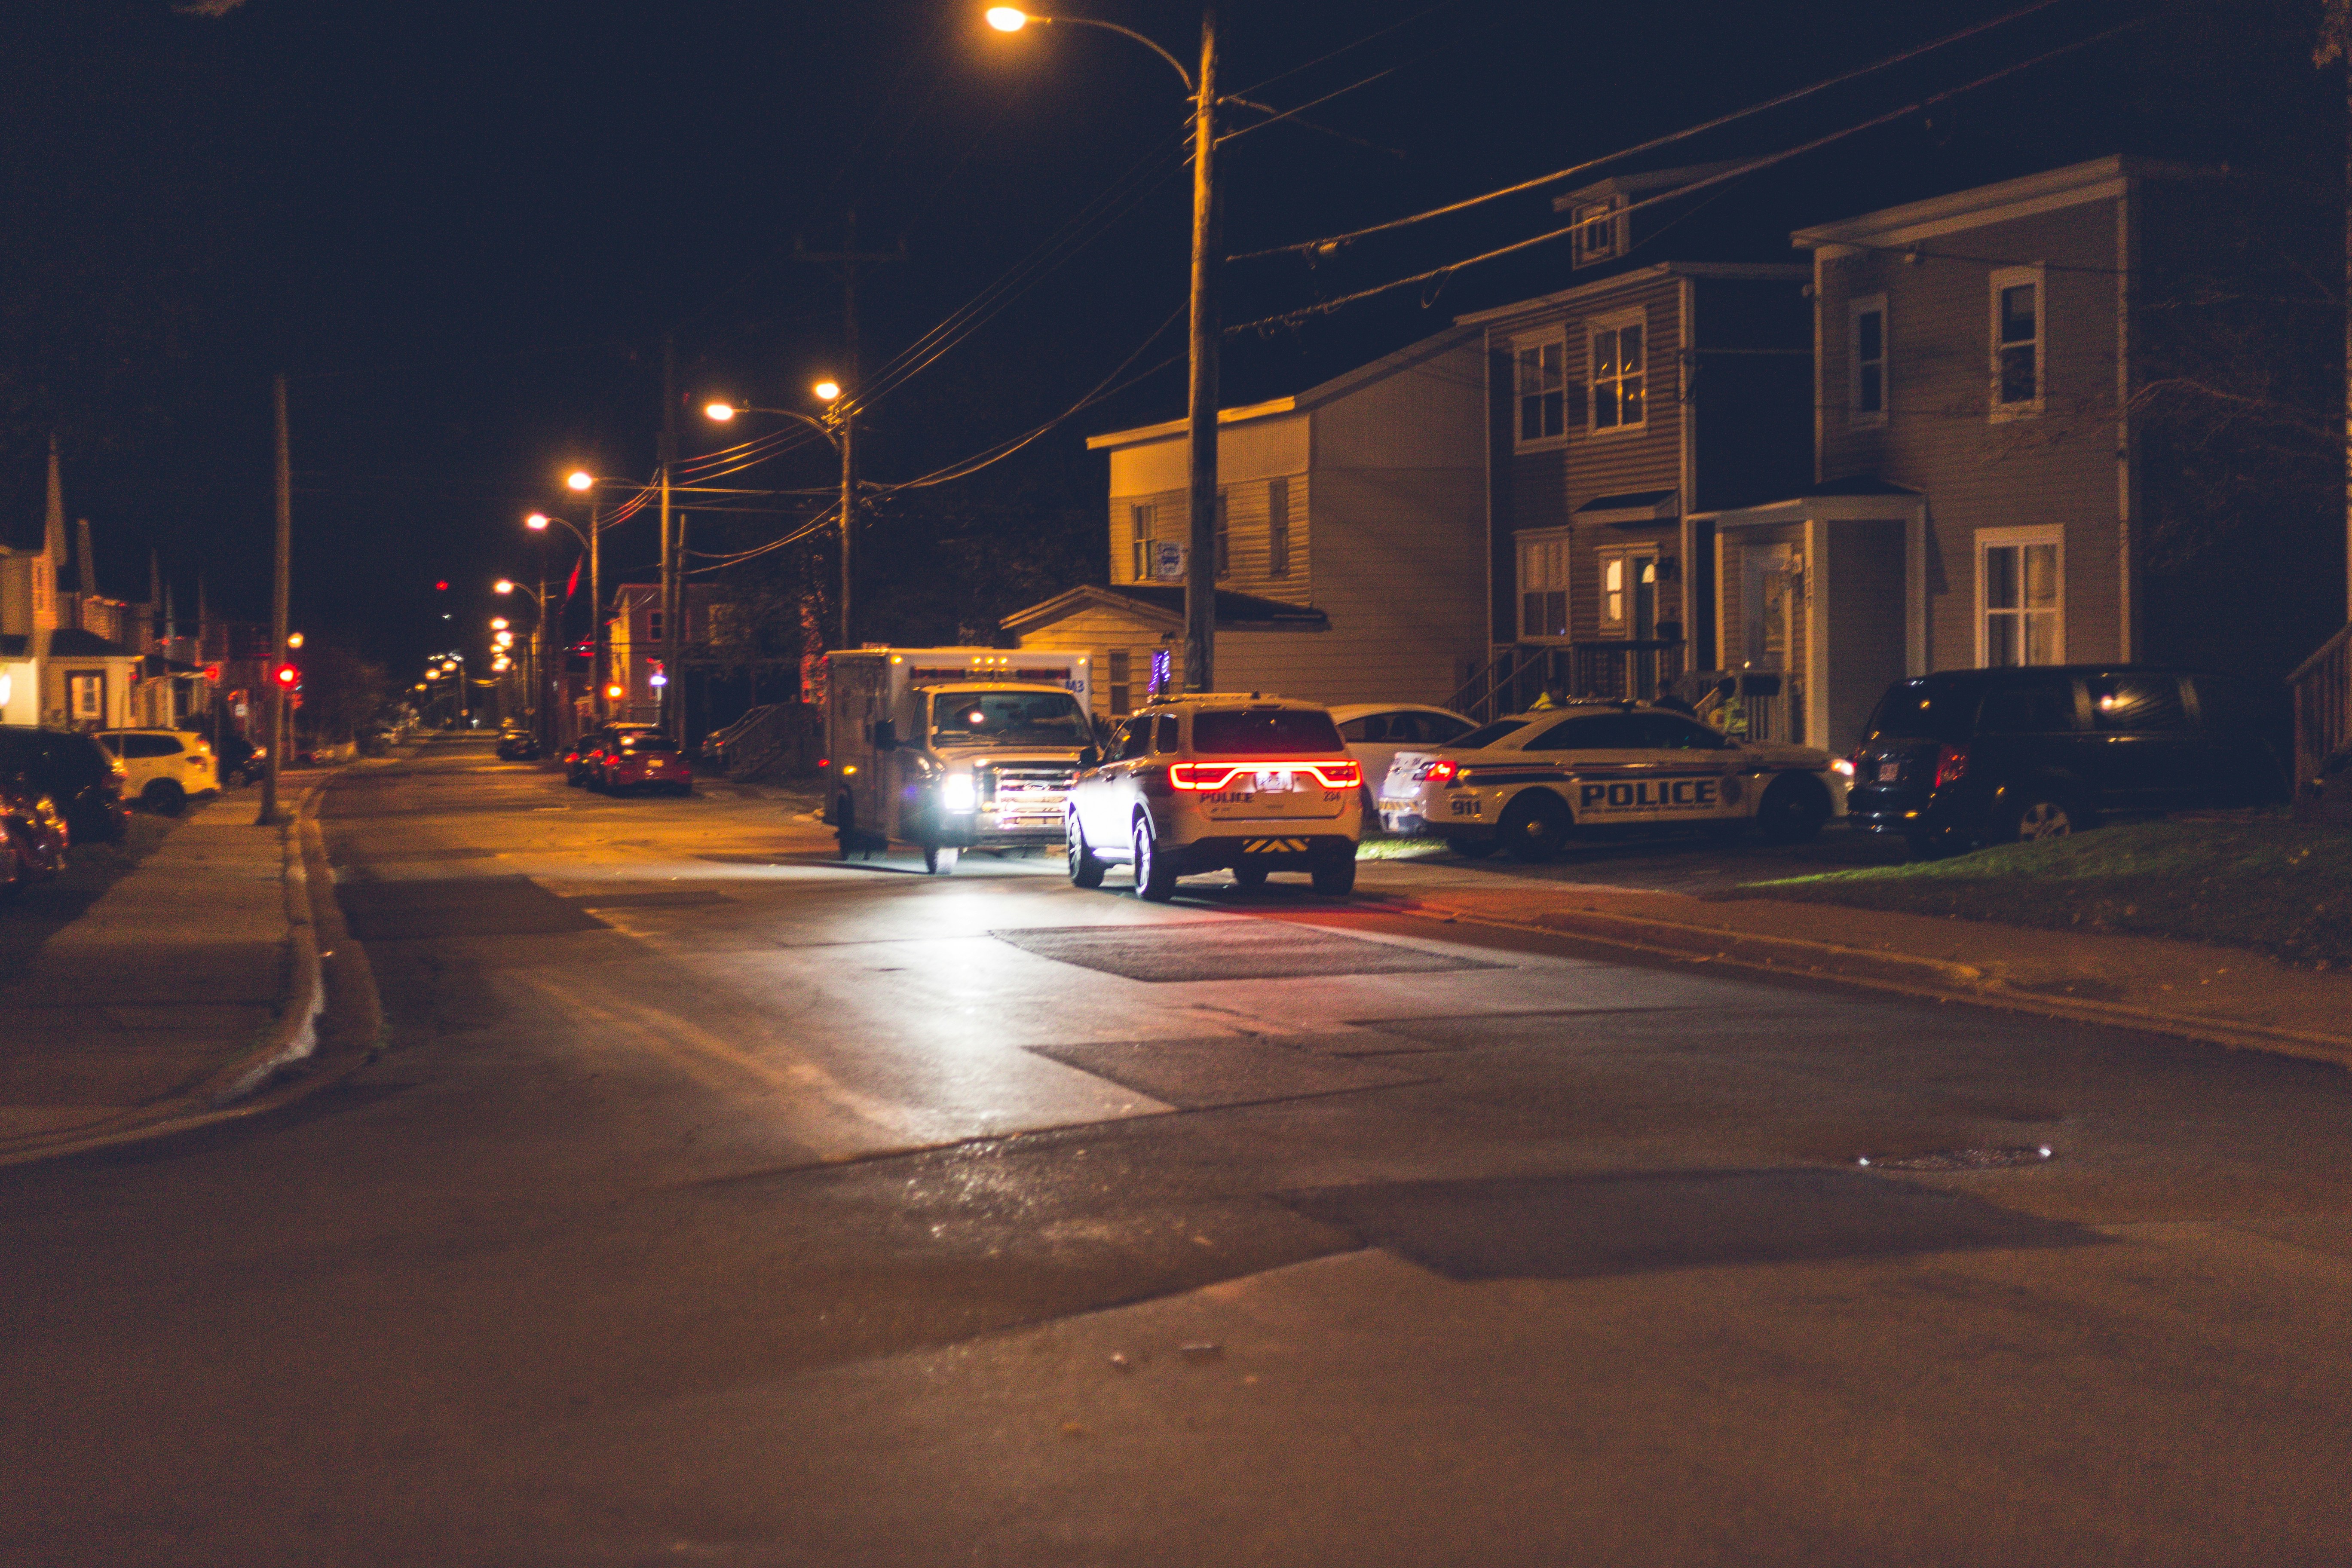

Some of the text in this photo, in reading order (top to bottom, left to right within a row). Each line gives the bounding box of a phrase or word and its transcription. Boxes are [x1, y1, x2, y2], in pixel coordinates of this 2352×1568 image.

[1065, 680, 1085, 692] M3
[1199, 792, 1254, 803] POLICE
[1580, 780, 1717, 807] POLICE
[1452, 800, 1482, 815] 911
